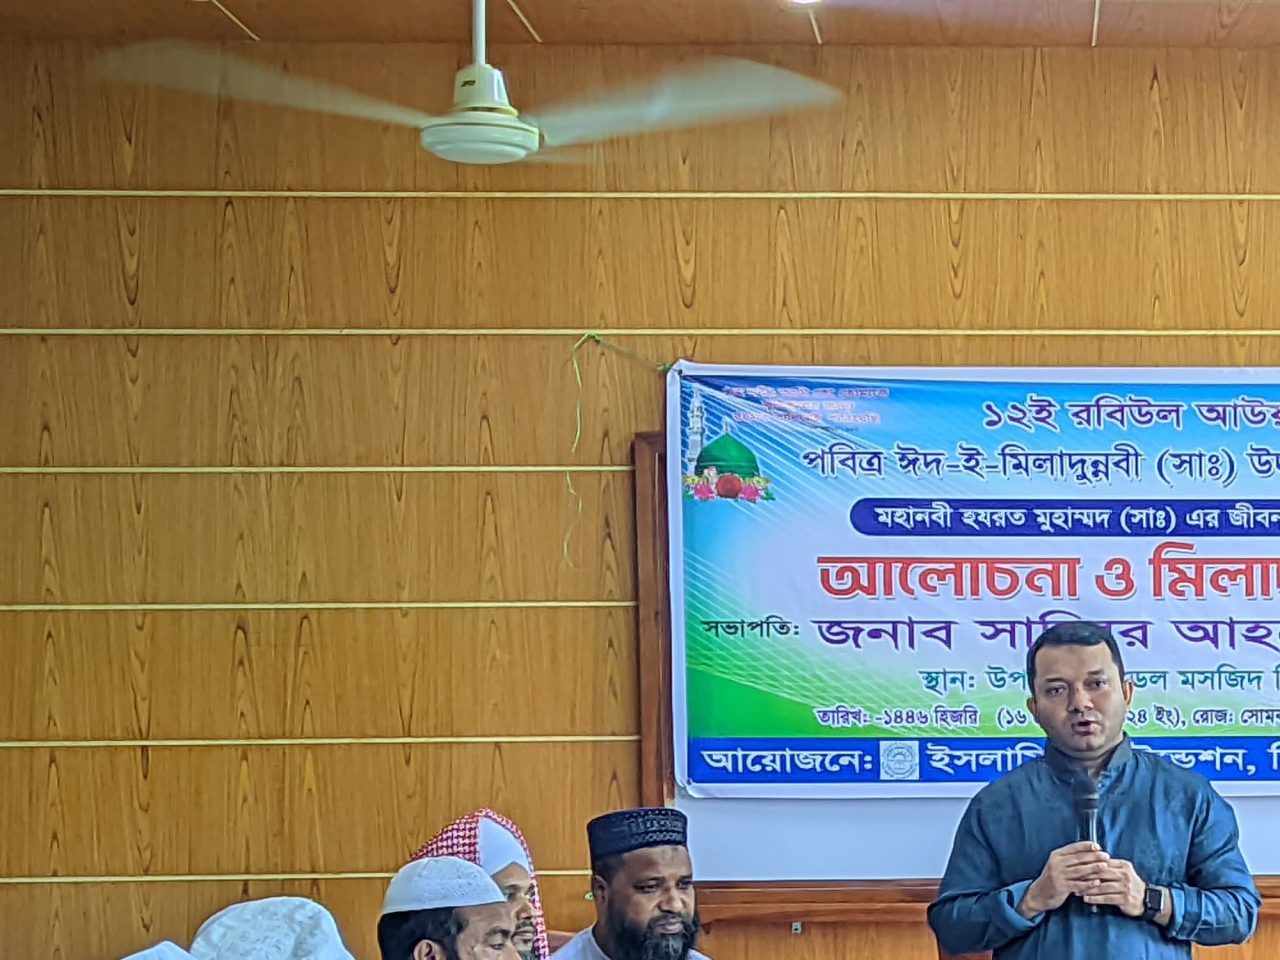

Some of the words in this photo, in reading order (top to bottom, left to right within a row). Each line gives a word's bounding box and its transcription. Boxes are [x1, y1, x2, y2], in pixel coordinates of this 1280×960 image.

[984, 396, 1058, 430] ১২ই
[1068, 396, 1184, 428] রবিউল
[803, 443, 884, 477] পবিত্র
[874, 501, 952, 529] মহানবী
[959, 507, 1026, 530] হযরত
[1035, 507, 1112, 532] মুহাম্মদ
[1186, 508, 1221, 528] এর
[817, 556, 1081, 599] আলোচনা
[1095, 558, 1134, 599] ও
[811, 616, 959, 651] জনাব
[1177, 663, 1265, 691] মসজিদ
[934, 705, 979, 727] হিজরি
